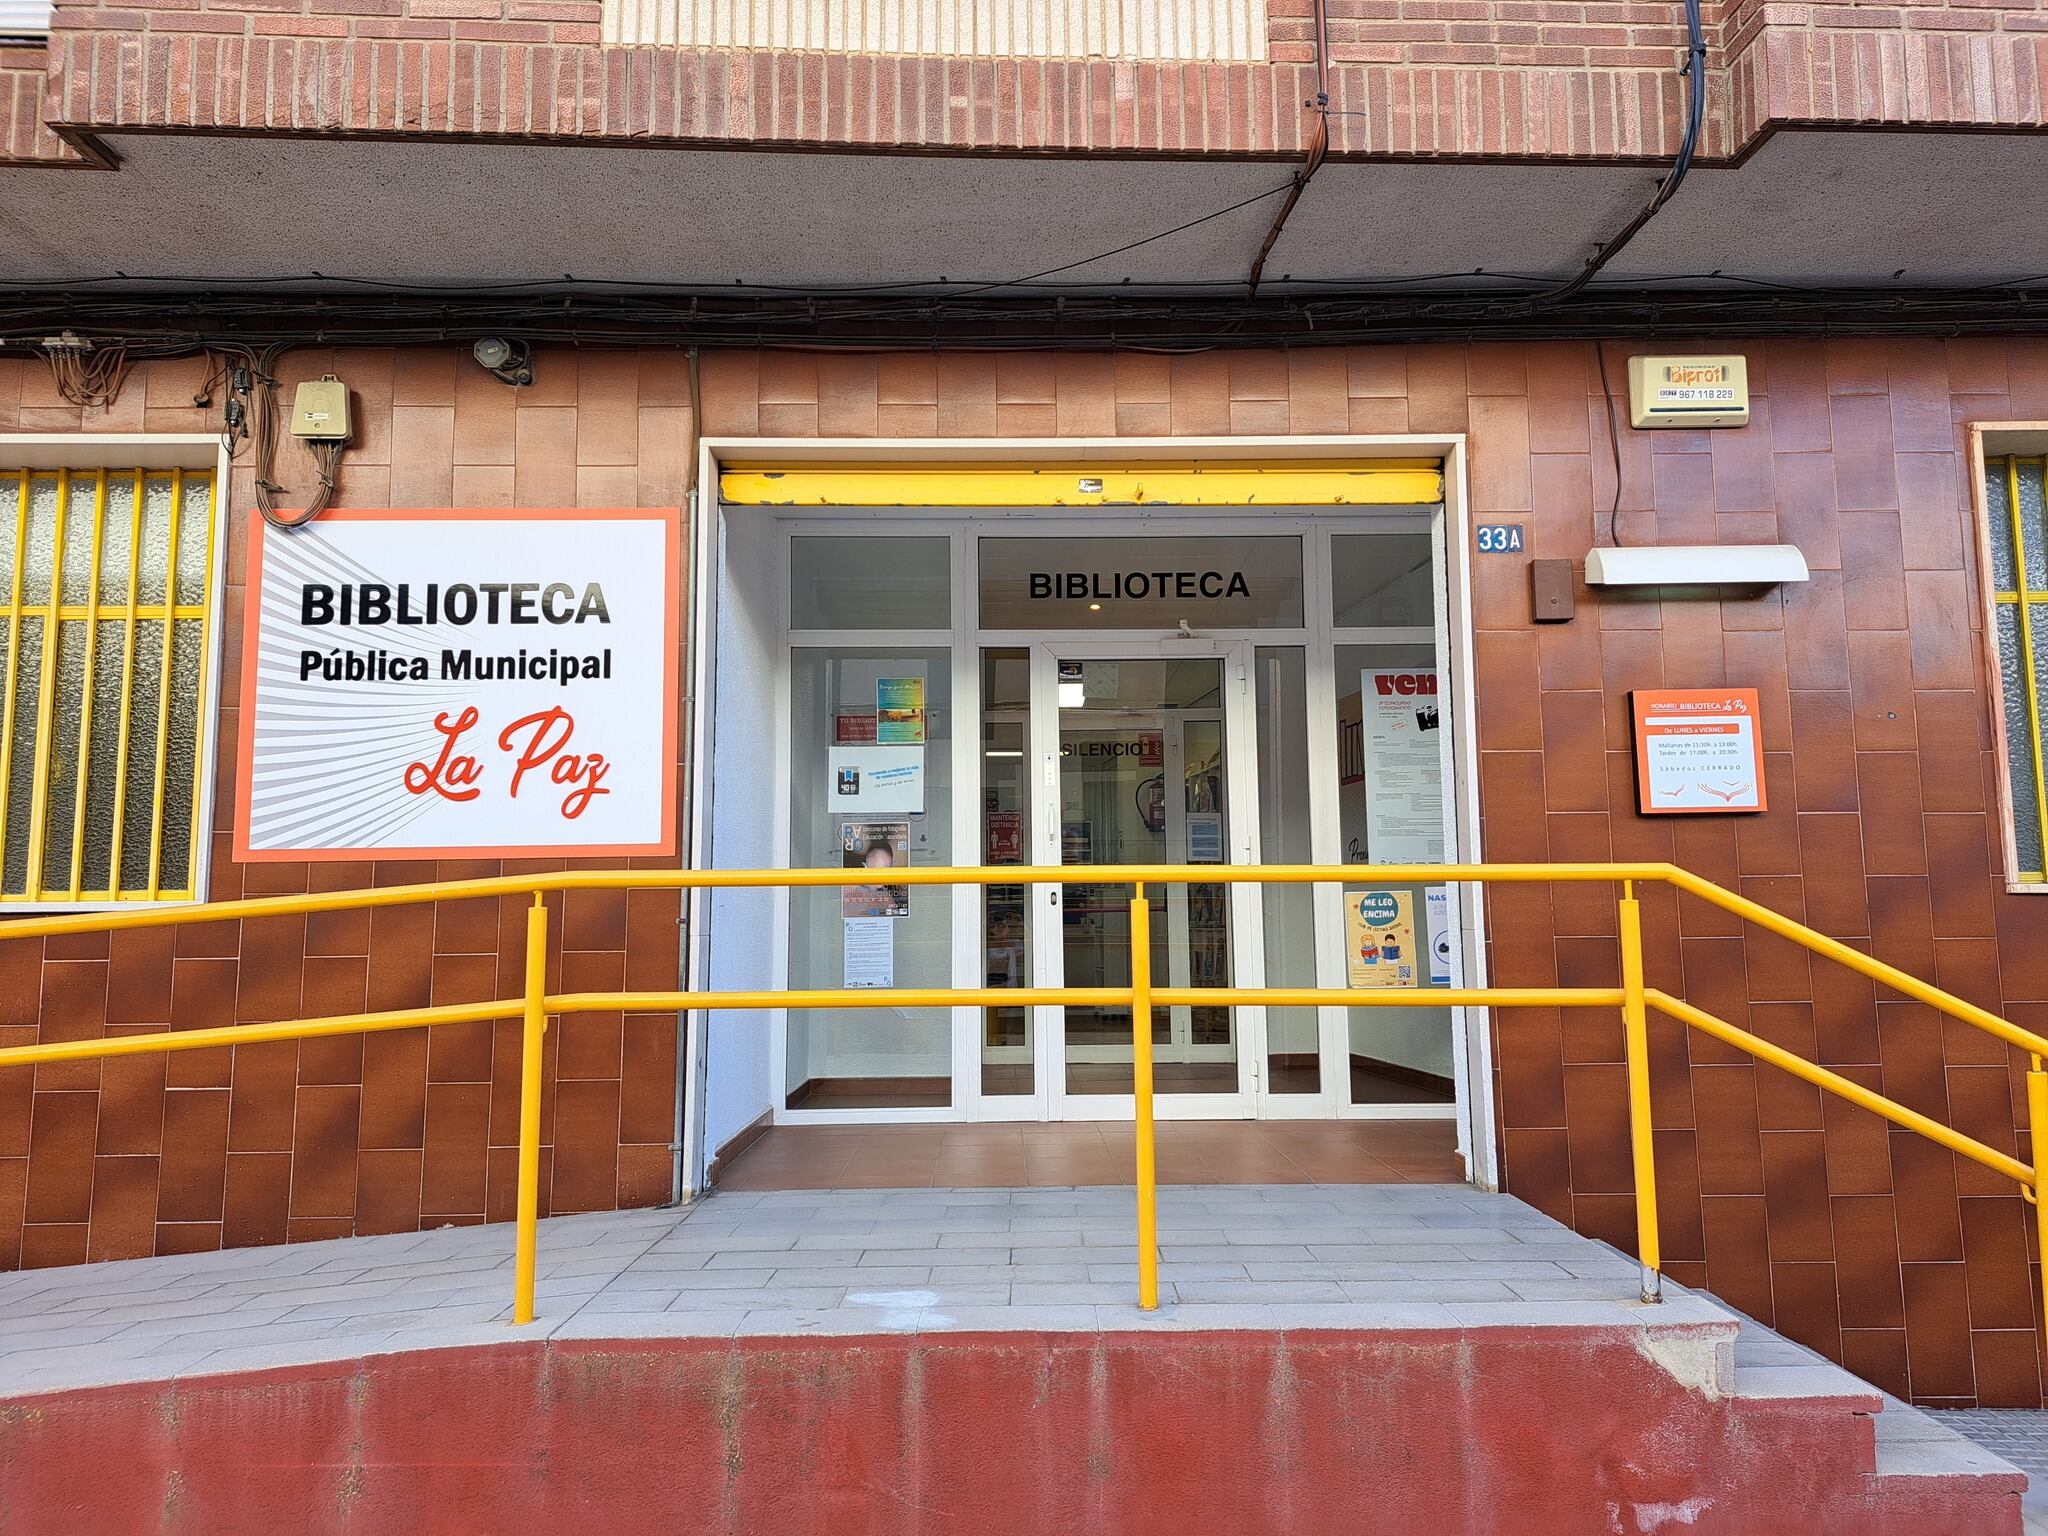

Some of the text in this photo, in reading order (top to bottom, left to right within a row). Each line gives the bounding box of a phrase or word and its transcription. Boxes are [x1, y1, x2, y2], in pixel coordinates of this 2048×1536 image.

[1679, 390, 1696, 399] 967
[1699, 390, 1715, 399] 118
[1717, 389, 1733, 399] 229
[1030, 571, 1250, 599] BIBLIOTECA
[301, 583, 611, 625] BIBLIOTECA
[300, 648, 611, 686] Pública Municipal
[1680, 702, 1721, 710] BIBLIOTECA
[1722, 699, 1732, 712] La
[1733, 699, 1748, 713] Paz
[1062, 742, 1143, 757] SILENCIO
[404, 705, 610, 819] La Paz
[1364, 898, 1393, 906] ME LEO
[1363, 910, 1395, 919] ENCIMA
